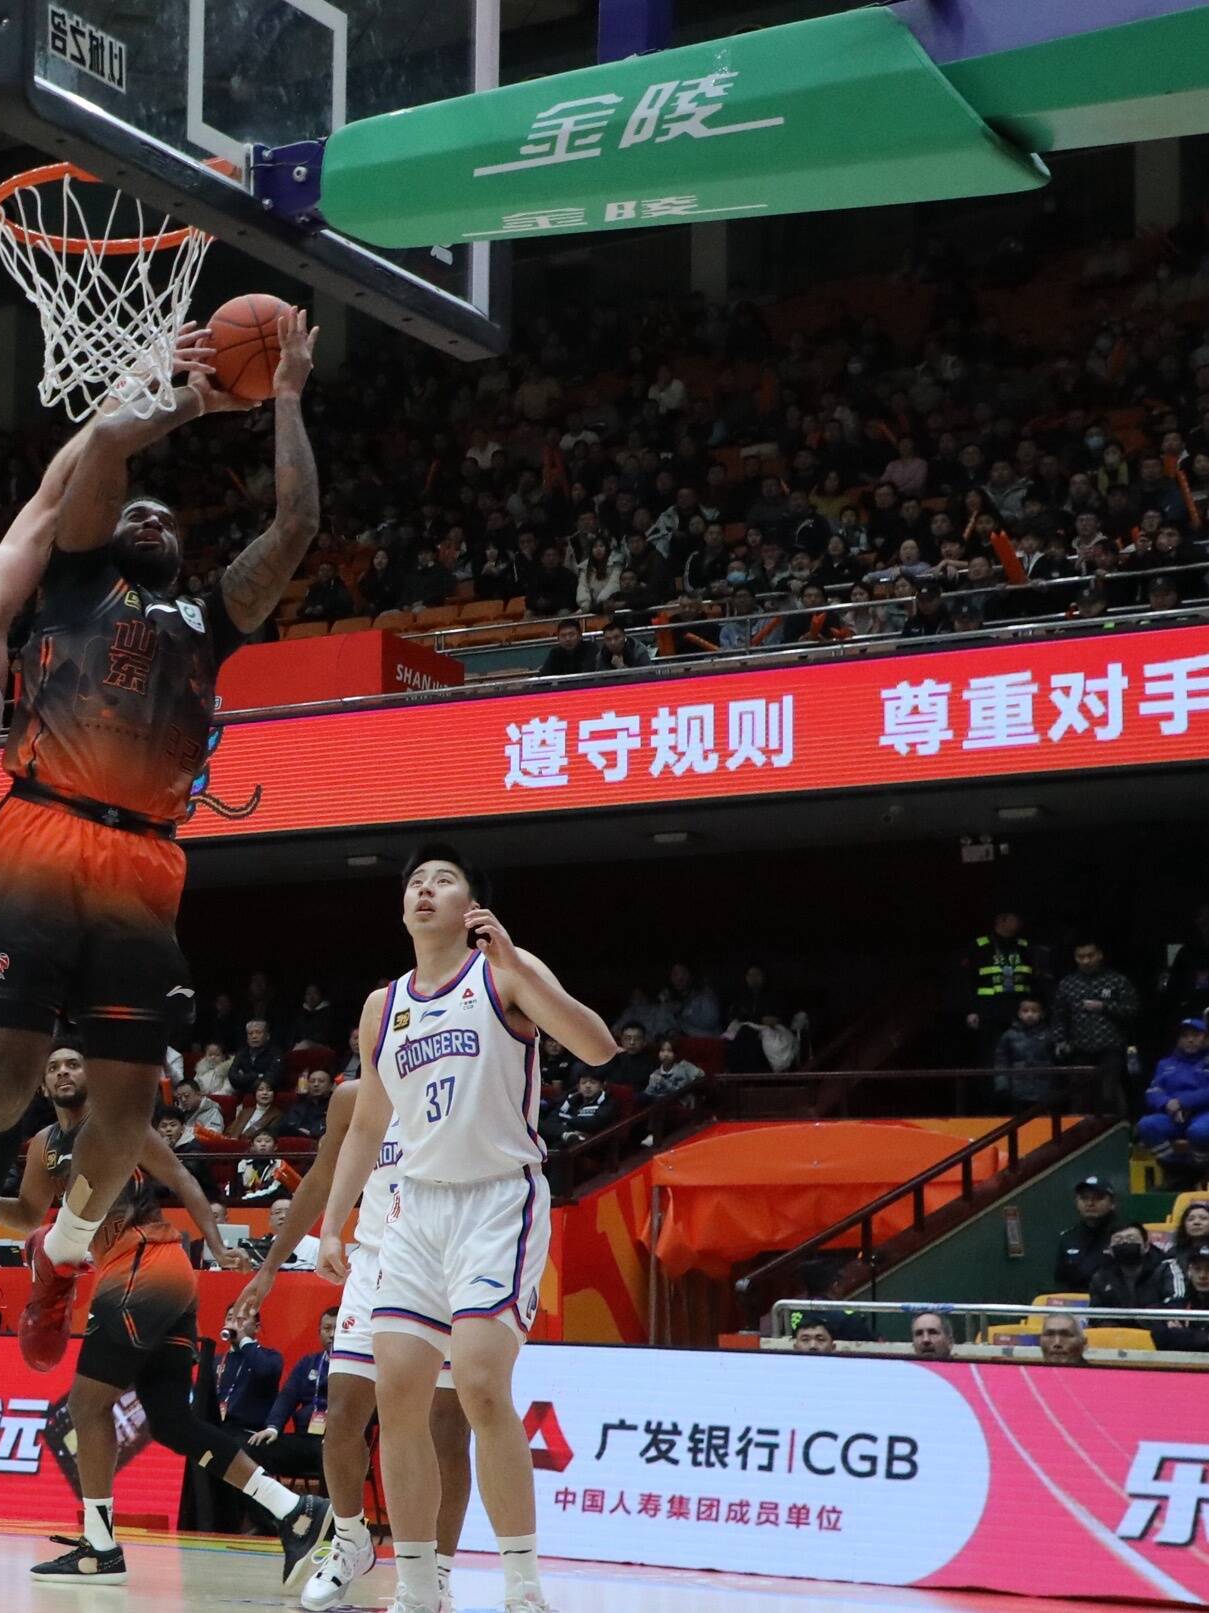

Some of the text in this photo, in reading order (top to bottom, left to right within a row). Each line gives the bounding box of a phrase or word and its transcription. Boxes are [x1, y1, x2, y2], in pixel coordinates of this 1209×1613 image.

[473, 72, 784, 177] 金陵
[463, 195, 768, 237] 金陵
[505, 654, 1209, 790] 遵守规则 尊重对手
[394, 1029, 480, 1079] PIONEERS
[425, 1076, 456, 1124] 37
[595, 1418, 920, 1481] 广发银行 CGB
[553, 1486, 845, 1533] 中国人寿集团成员单位
